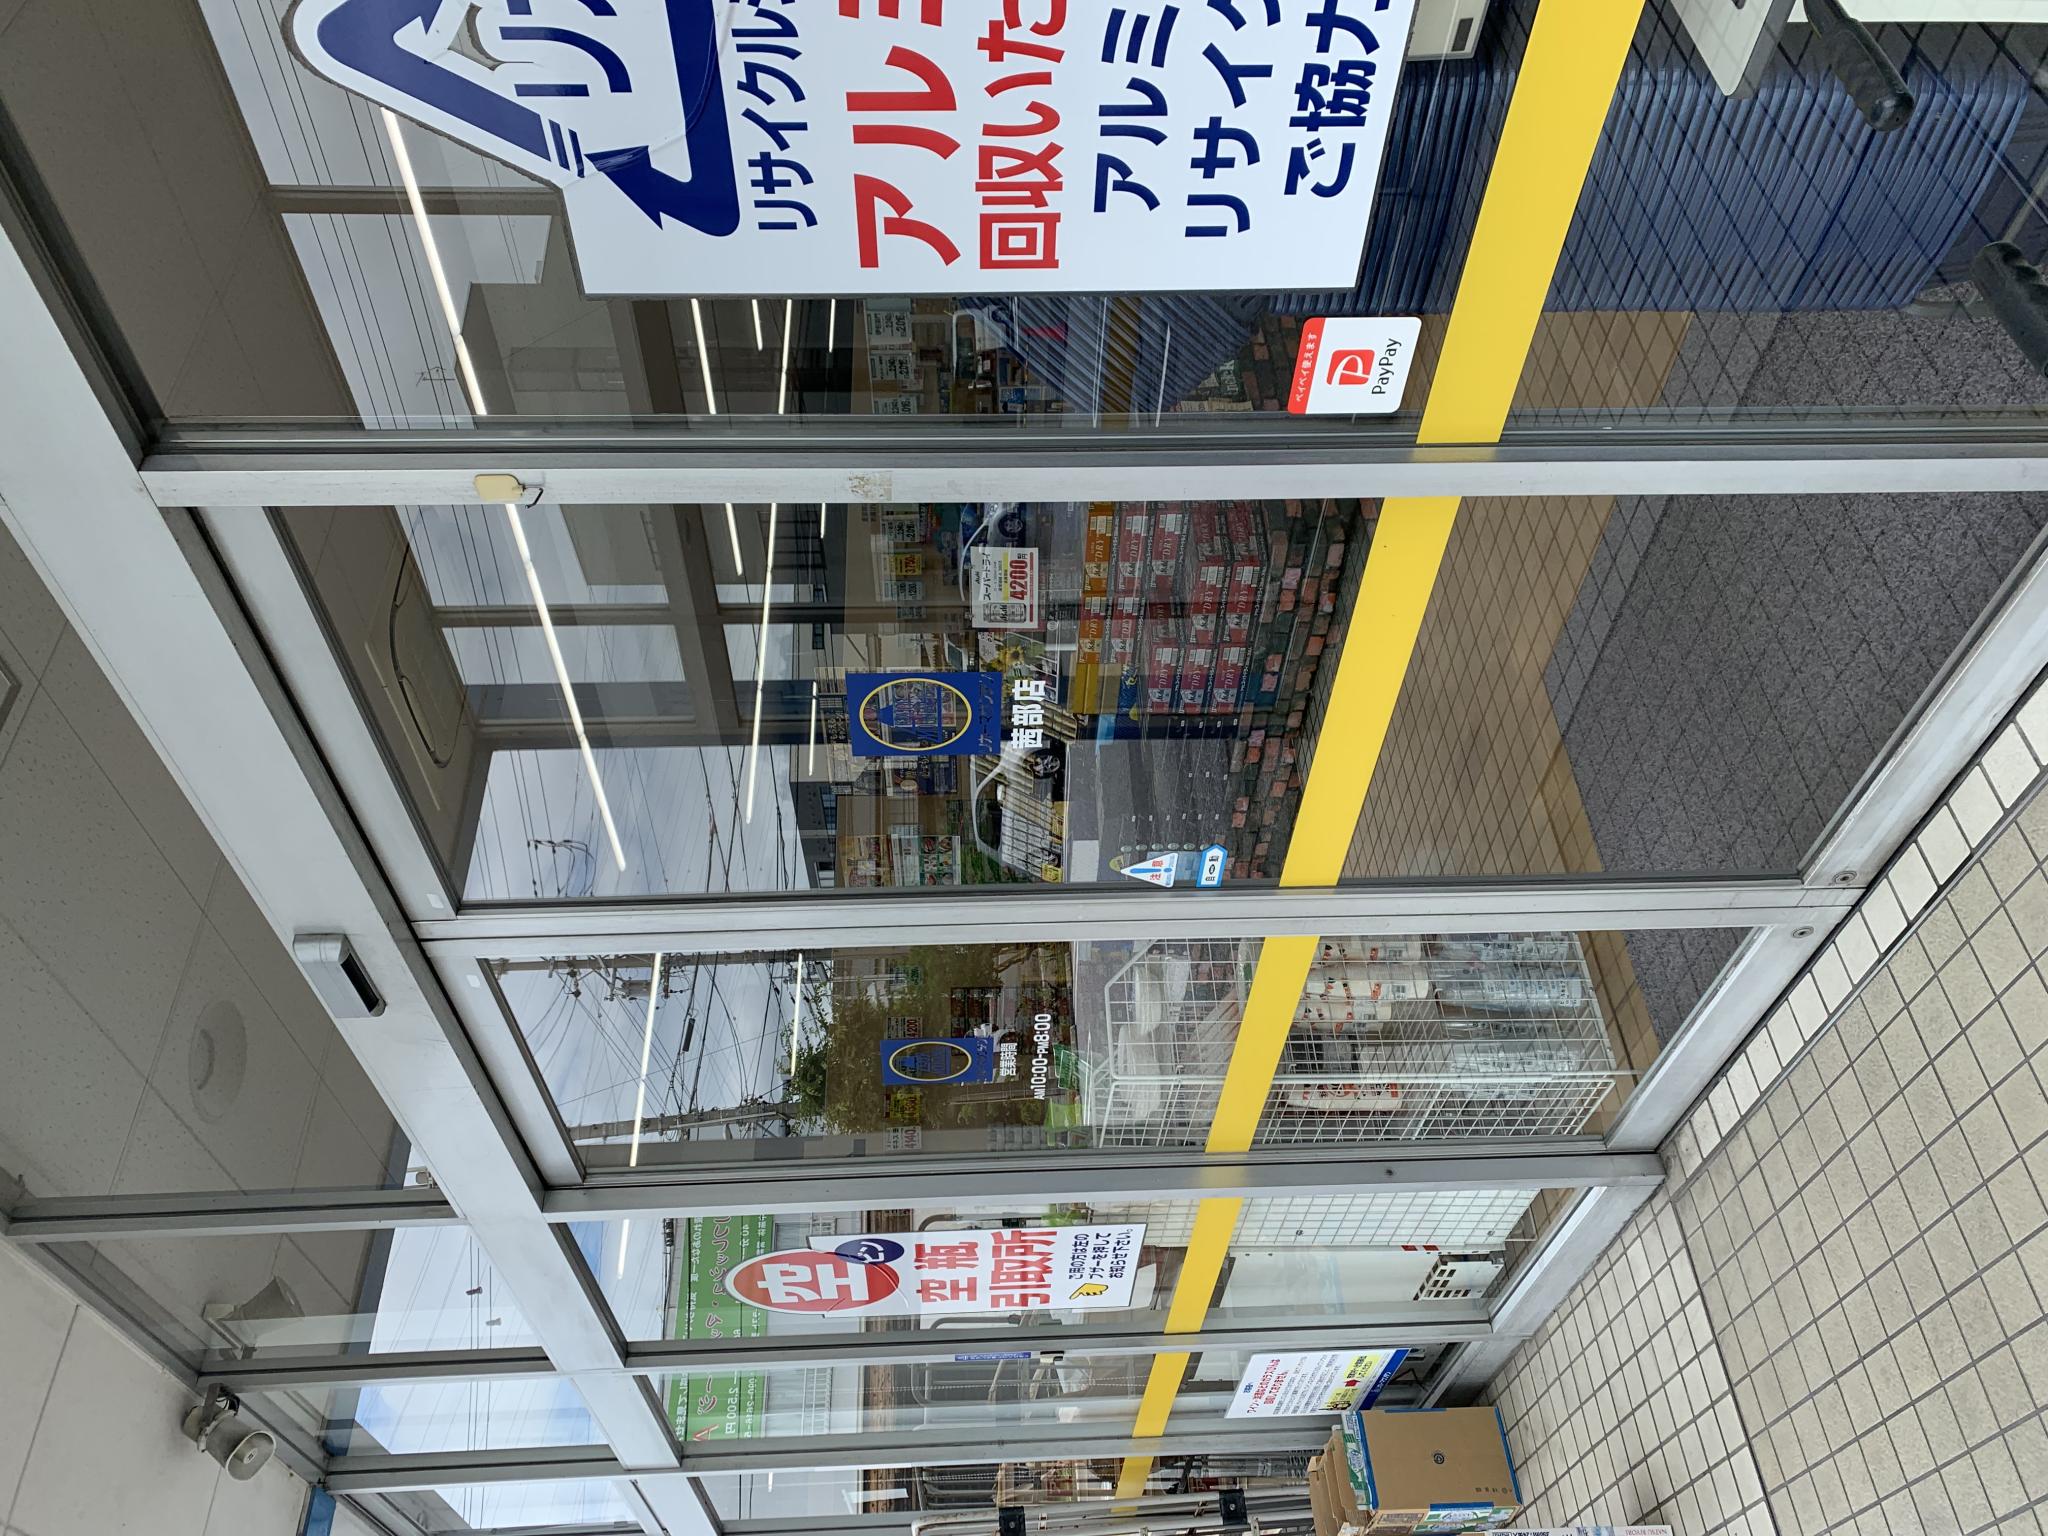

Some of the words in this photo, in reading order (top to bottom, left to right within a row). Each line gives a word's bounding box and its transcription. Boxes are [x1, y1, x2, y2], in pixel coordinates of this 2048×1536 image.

[499, 0, 632, 97] リ
[729, 0, 818, 230] リサイクル
[974, 0, 1066, 269] 回収いた
[1093, 5, 1181, 214] アルミ
[1295, 332, 1317, 402] ペイペイ使えます
[1371, 338, 1402, 395] PayPay
[1010, 679, 1046, 749] 茜部店
[1000, 1042, 1018, 1077] 営業時間
[756, 1260, 870, 1304] 空
[855, 1240, 887, 1265] ビン
[988, 1230, 1058, 1308] 引取所
[1068, 1233, 1090, 1280] ご用の方は左の
[1088, 1232, 1112, 1280] ブザーを押して
[1108, 1228, 1134, 1279] お知らせ下さい。
